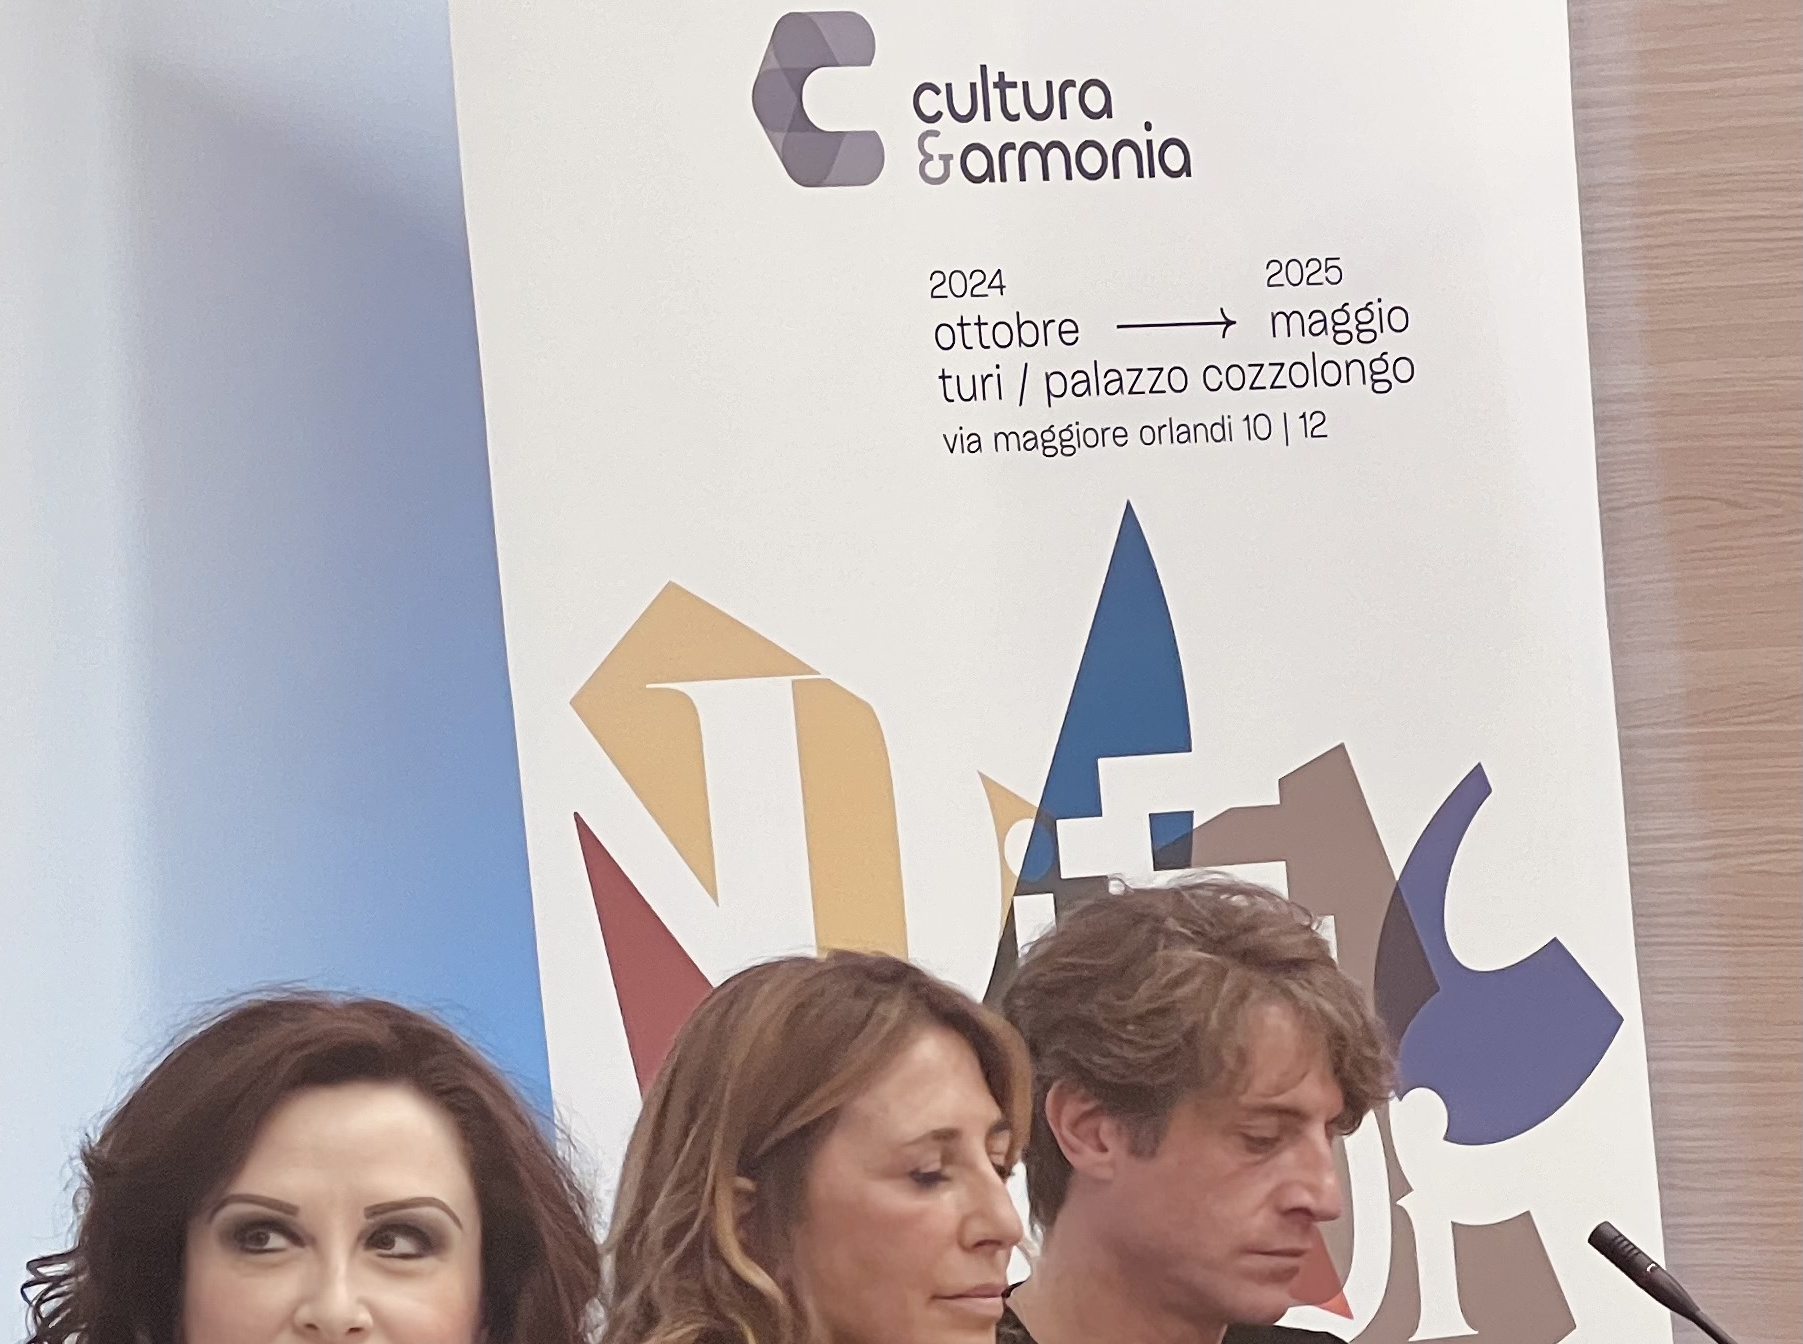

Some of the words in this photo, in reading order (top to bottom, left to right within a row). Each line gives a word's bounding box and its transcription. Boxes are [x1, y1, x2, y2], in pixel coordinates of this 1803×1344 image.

[912, 63, 1114, 125] cultura
[929, 268, 1007, 300] 2024
[1265, 256, 1343, 288] 2025
[934, 310, 1080, 352] ottobre
[1270, 297, 1410, 346] maggio
[937, 363, 1003, 404] turi
[1044, 359, 1189, 409] palazzo
[1202, 350, 1415, 395] cozzolongo
[942, 425, 983, 455] via
[993, 420, 1129, 459] maggiore
[1139, 414, 1234, 447] orlandi
[1241, 412, 1273, 442] 10
[1298, 409, 1329, 439] 12
